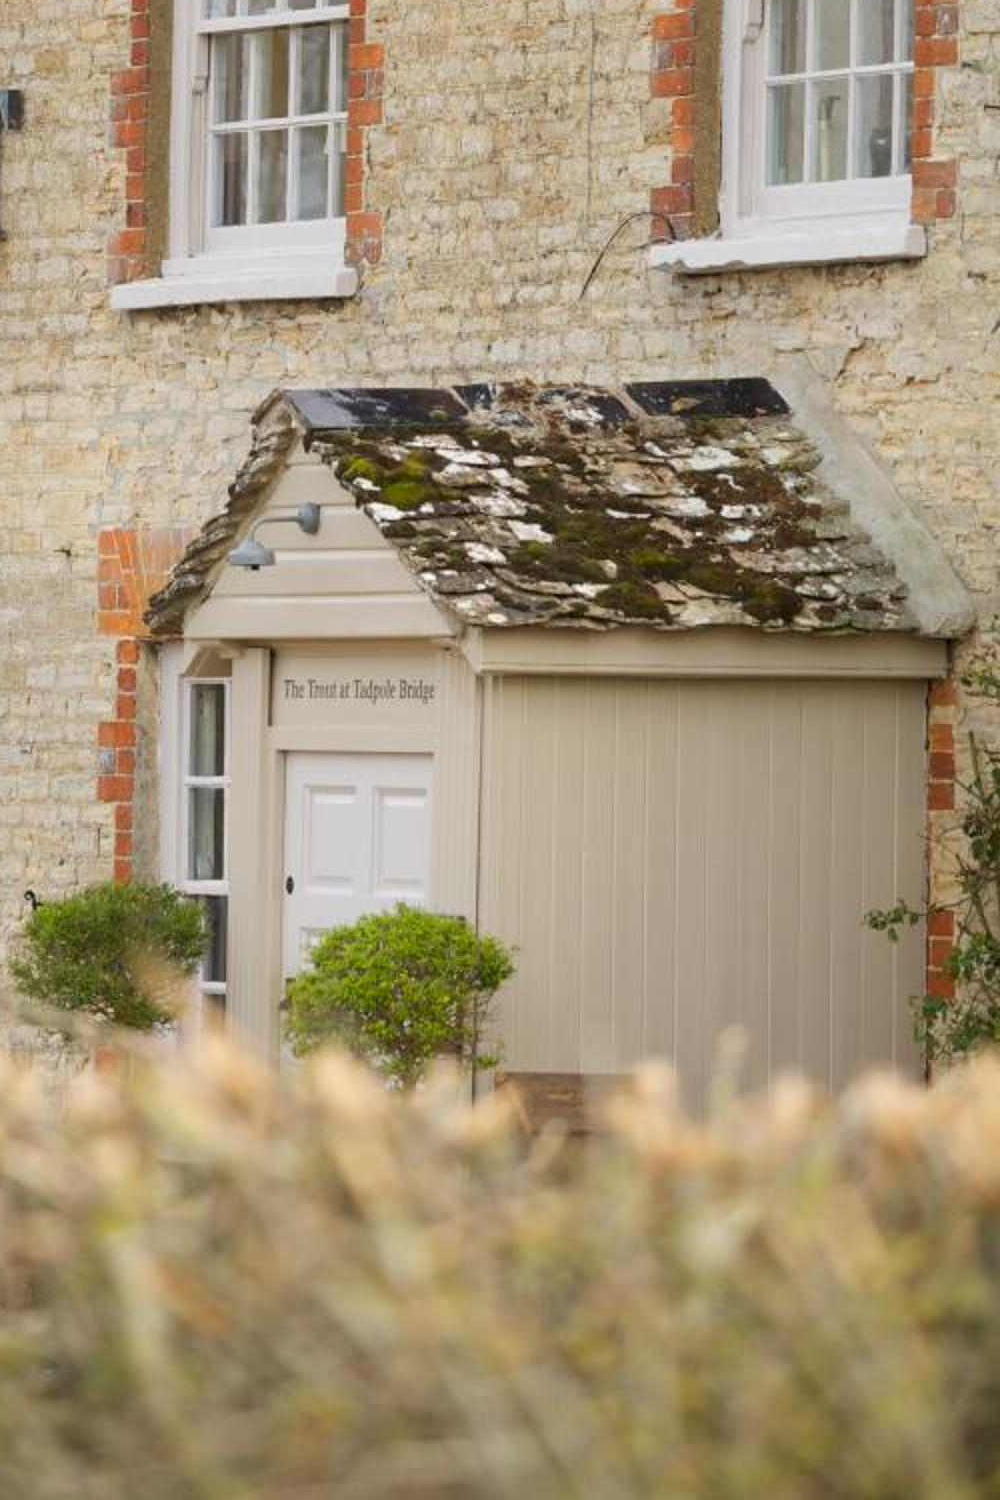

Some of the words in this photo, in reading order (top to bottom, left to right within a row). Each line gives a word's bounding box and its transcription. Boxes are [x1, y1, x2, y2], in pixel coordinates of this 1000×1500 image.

[284, 679, 304, 699] The
[308, 679, 337, 699] Trout
[339, 682, 350, 699] at
[354, 679, 396, 704] Tadpole
[399, 679, 435, 704] Bridge
